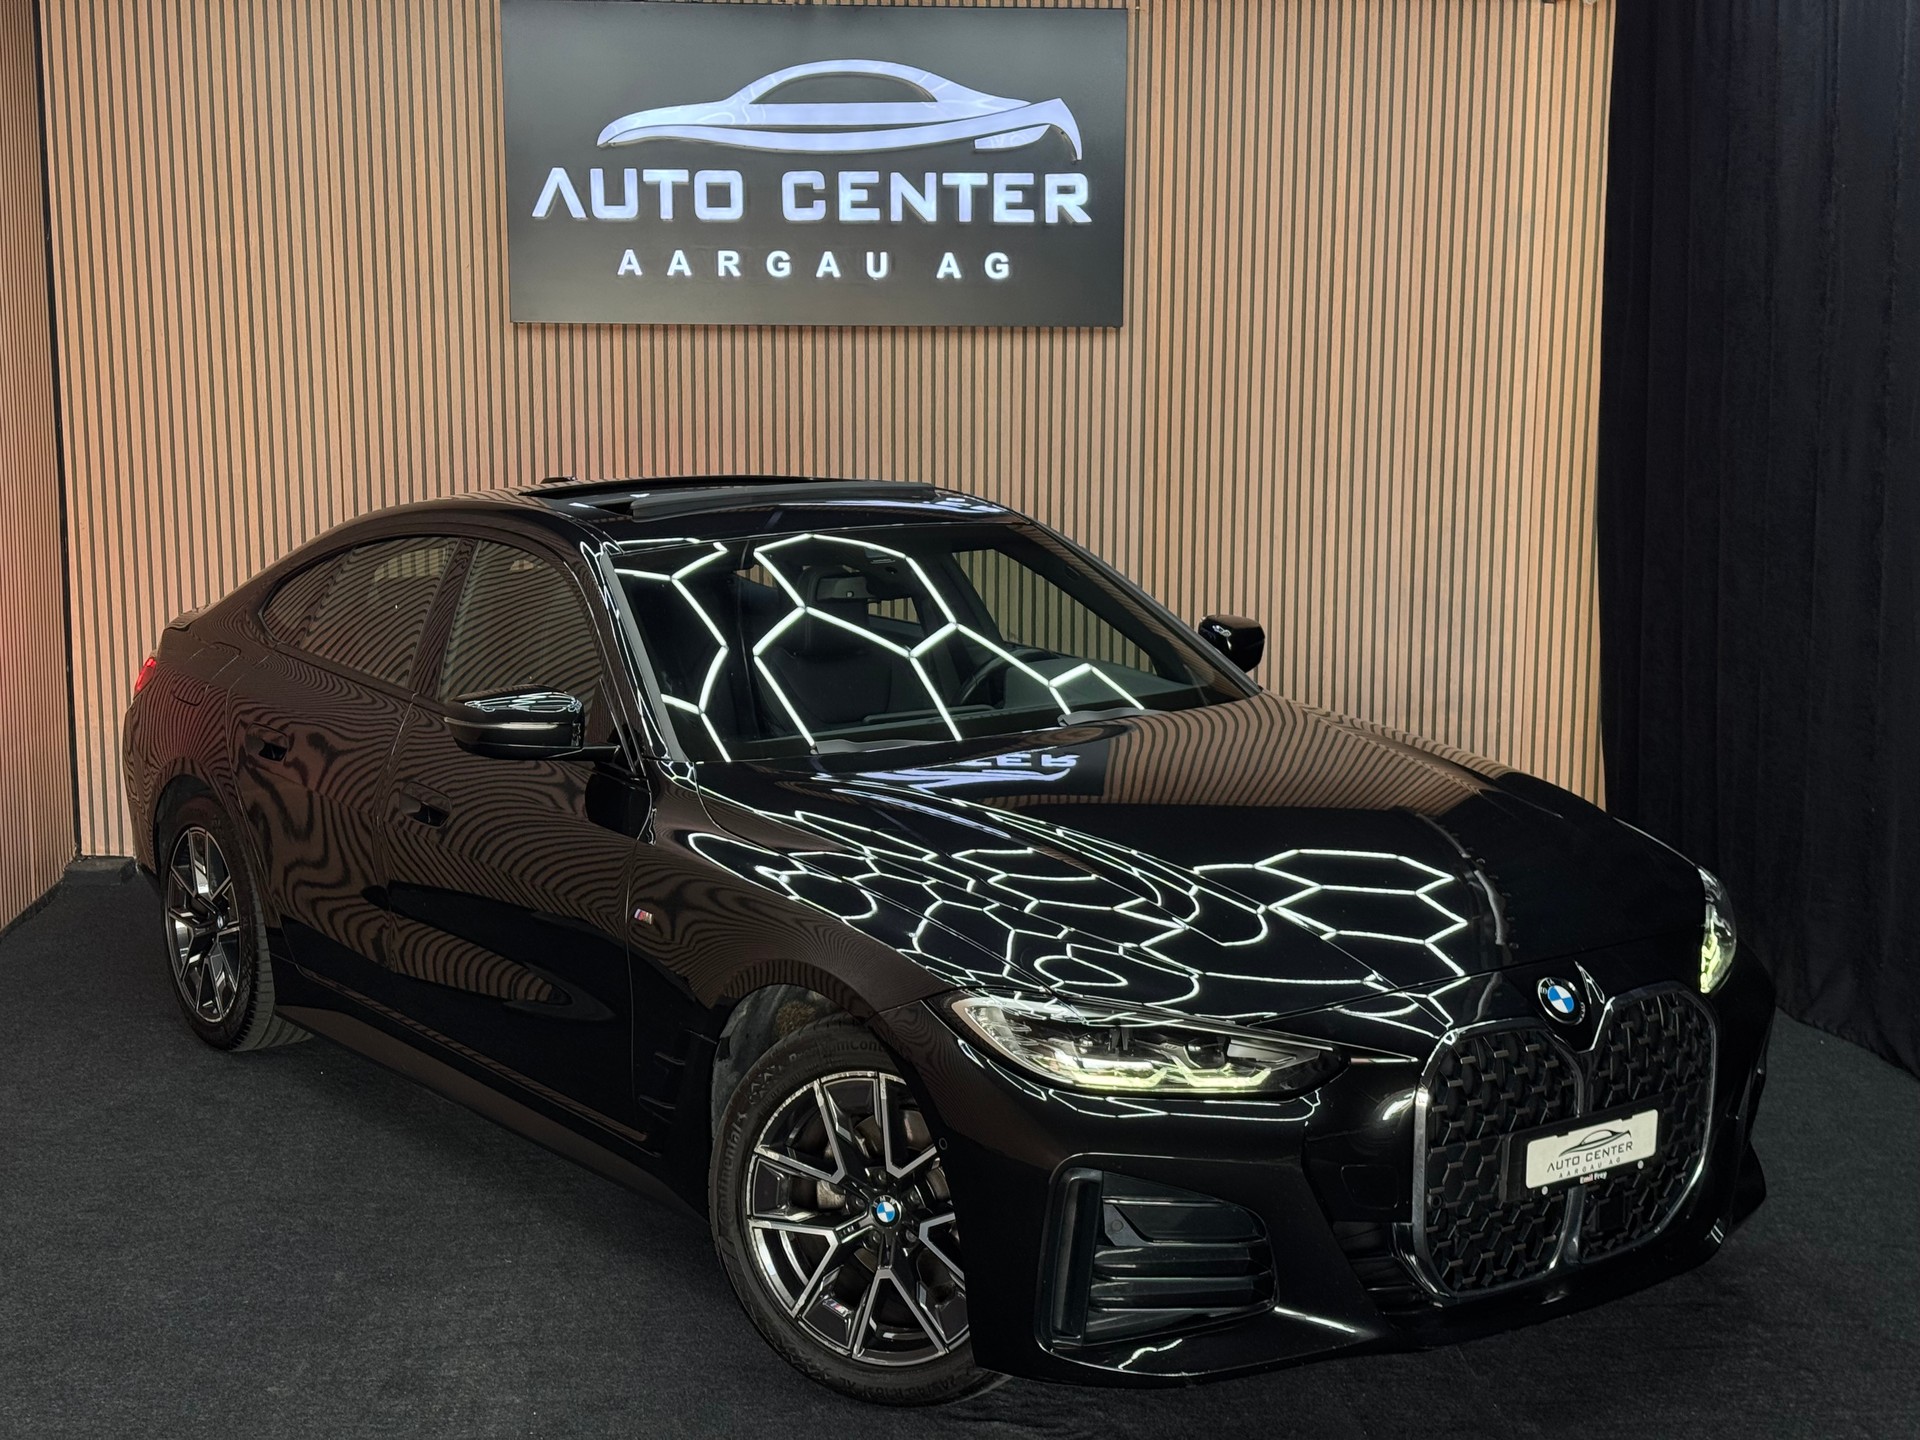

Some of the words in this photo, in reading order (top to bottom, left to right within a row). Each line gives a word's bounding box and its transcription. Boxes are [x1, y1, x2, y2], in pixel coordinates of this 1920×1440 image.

[532, 168, 743, 221] AUTO
[782, 171, 1091, 223] CENTER
[618, 249, 888, 280] AARGAU
[937, 252, 1009, 279] AG
[1547, 1156, 1580, 1173] AUTO
[1585, 1141, 1633, 1162] CENTER
[1559, 1162, 1603, 1179] AARGAU
